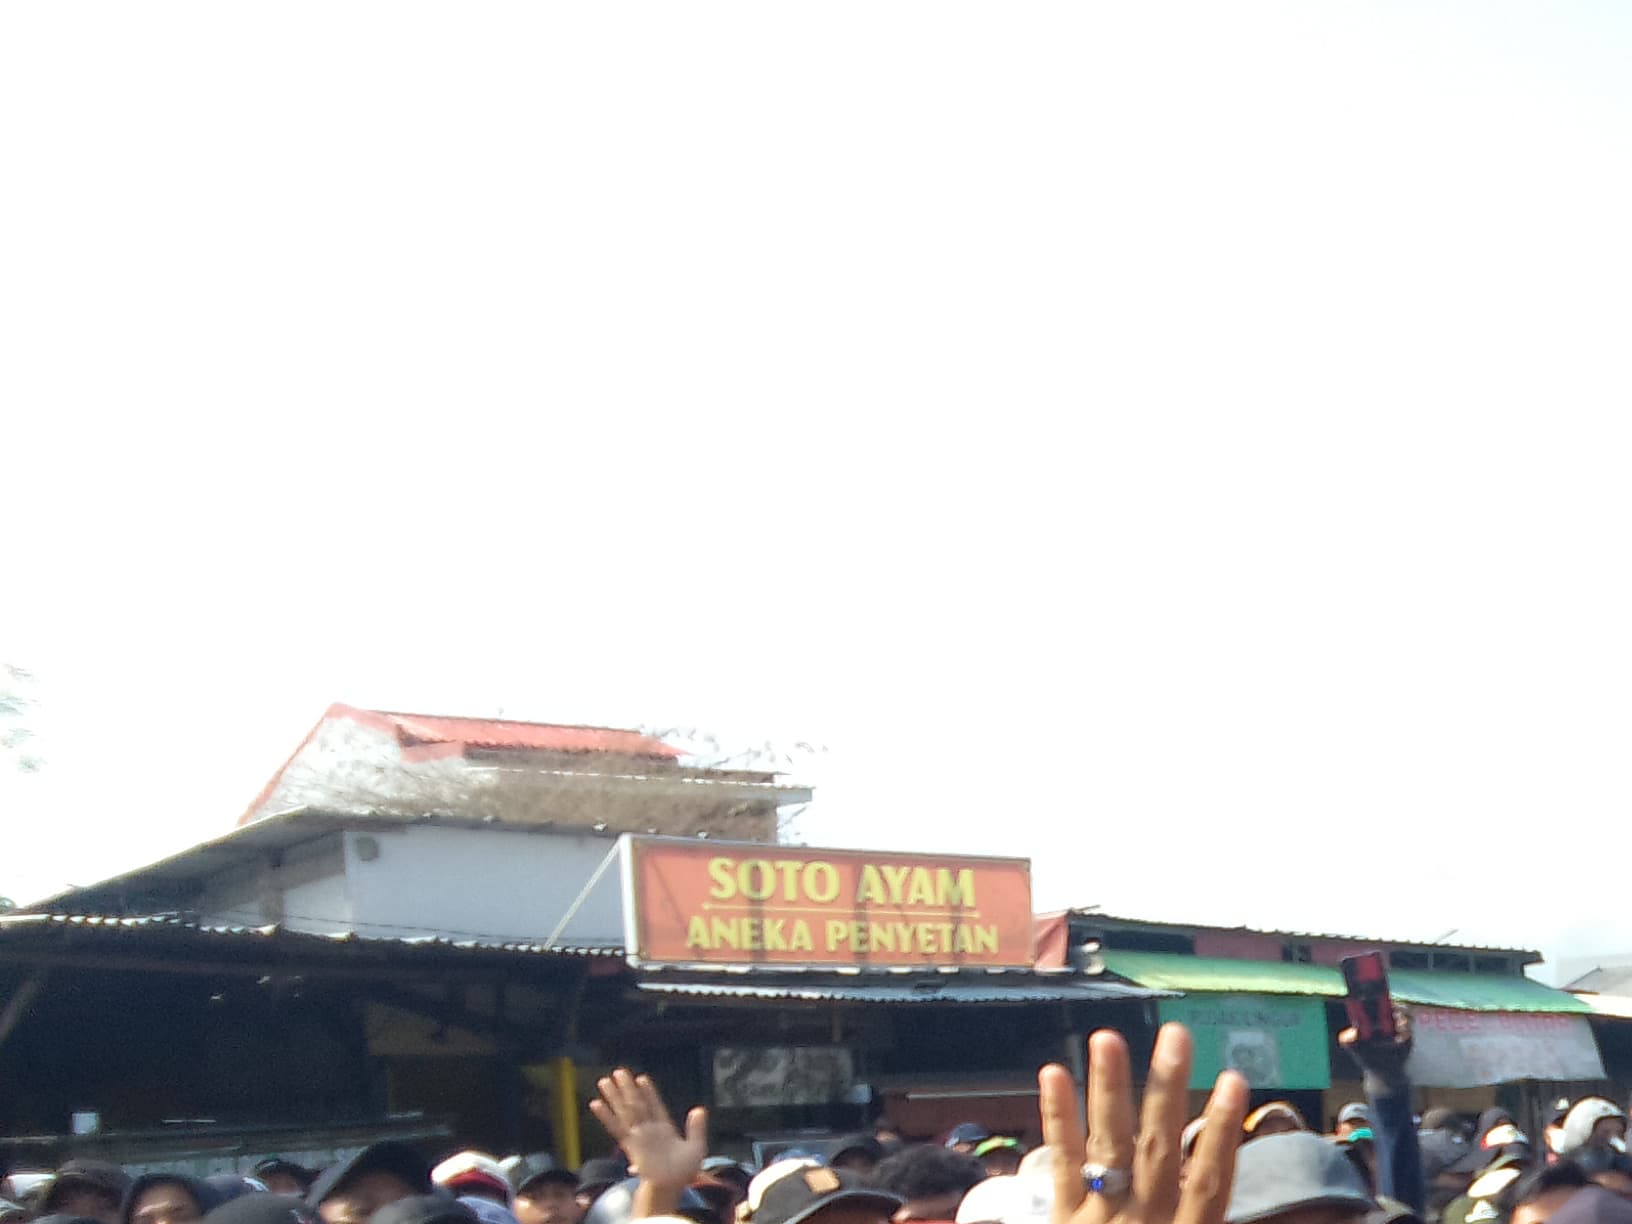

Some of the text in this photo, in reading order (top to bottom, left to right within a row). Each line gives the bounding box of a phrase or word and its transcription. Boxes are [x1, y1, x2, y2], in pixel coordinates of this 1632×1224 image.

[708, 857, 975, 907] SOTO AYAM
[686, 916, 999, 954] ANEKA PENYETAN
